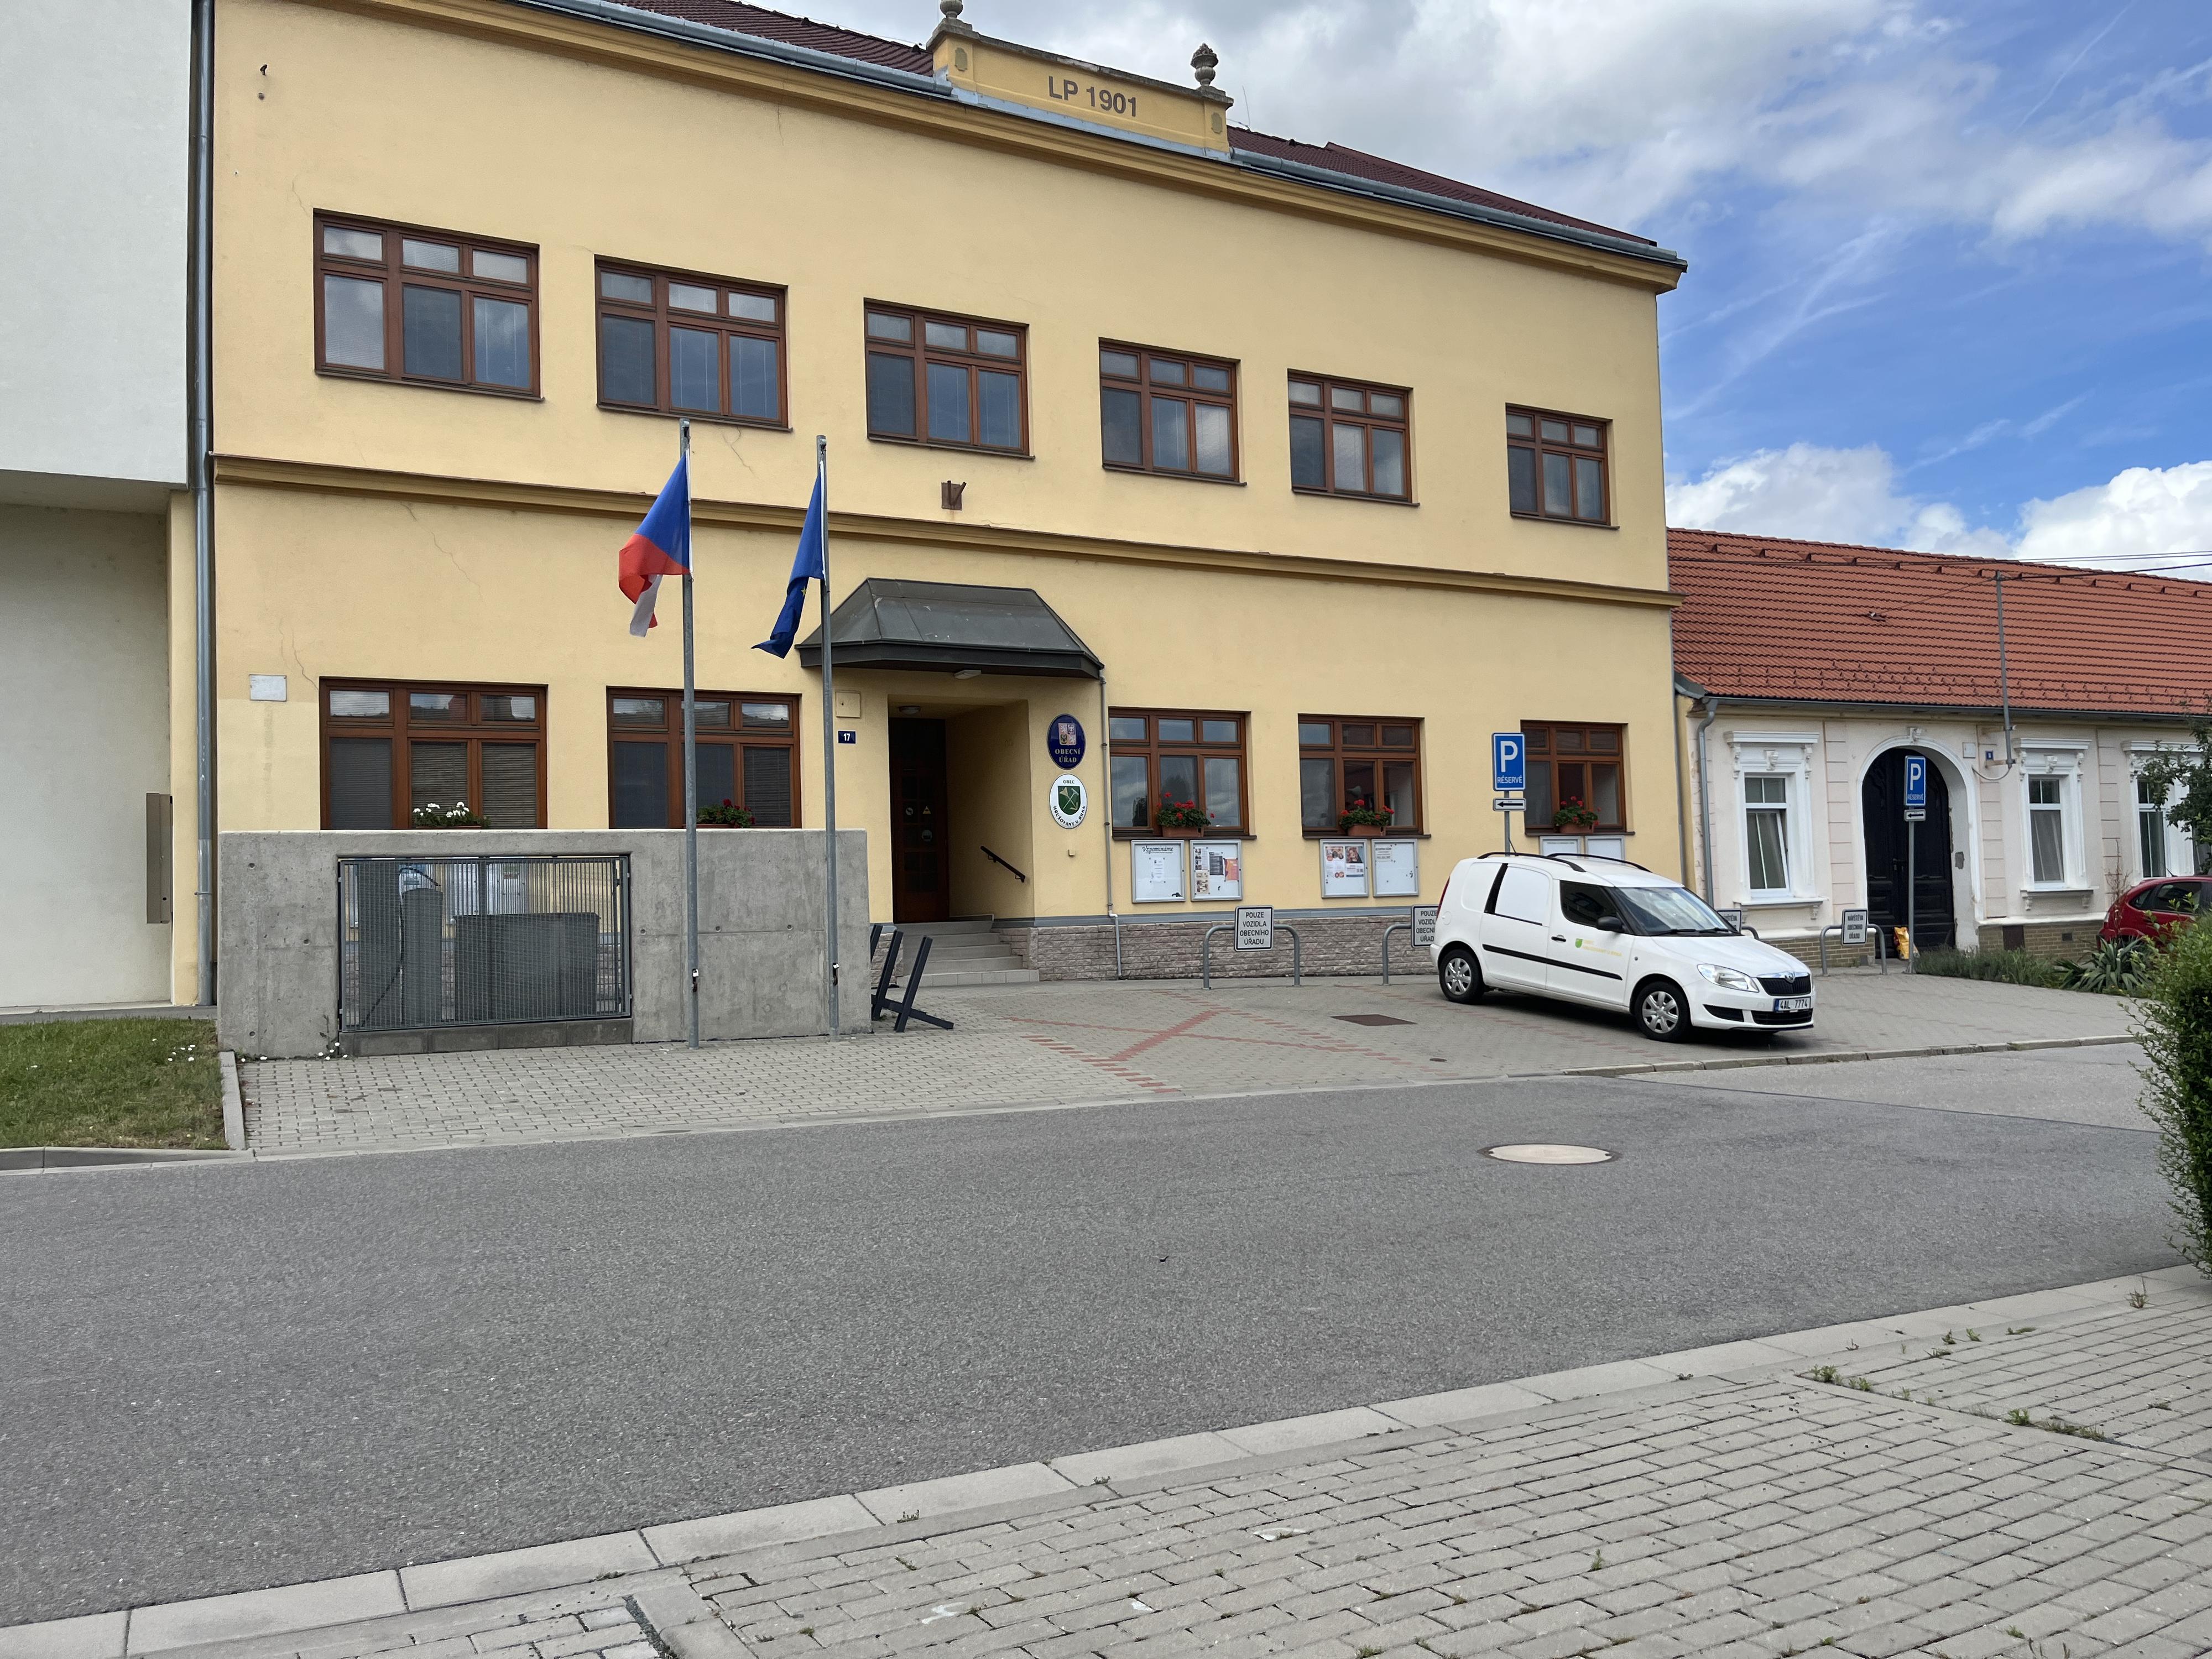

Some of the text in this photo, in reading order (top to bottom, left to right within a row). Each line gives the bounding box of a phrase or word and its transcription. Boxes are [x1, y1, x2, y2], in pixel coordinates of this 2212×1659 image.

[1048, 75, 1136, 117] LP 1901
[843, 733, 851, 741] 17
[1500, 740, 1518, 773] P
[1497, 775, 1522, 784] RÉSERVÉ
[1910, 763, 1921, 791] P
[1780, 999, 1808, 1009] 4AL 7774
